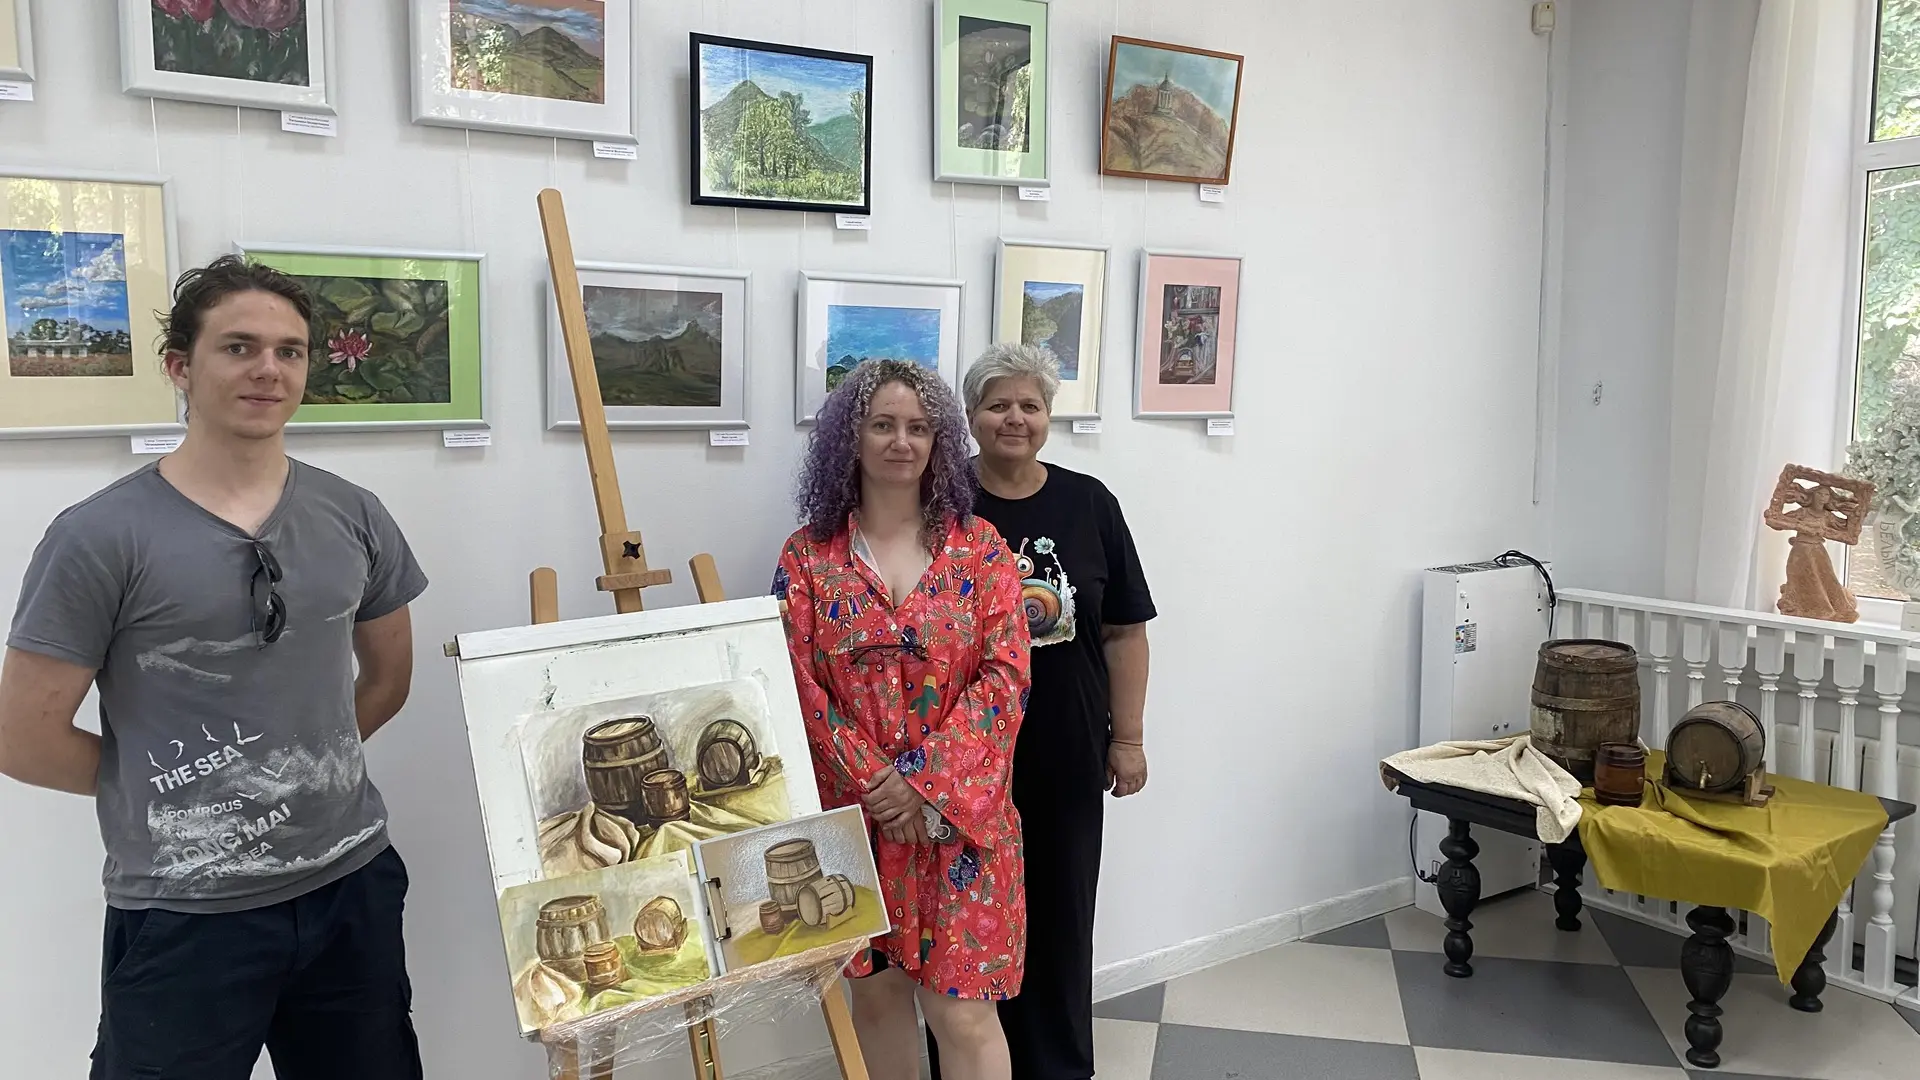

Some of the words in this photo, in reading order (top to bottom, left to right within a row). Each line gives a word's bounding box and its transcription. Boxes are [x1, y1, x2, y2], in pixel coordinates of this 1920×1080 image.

[149, 764, 196, 794] THE
[194, 745, 243, 776] SEA
[241, 803, 291, 842] MAI
[239, 841, 273, 862] SEA
